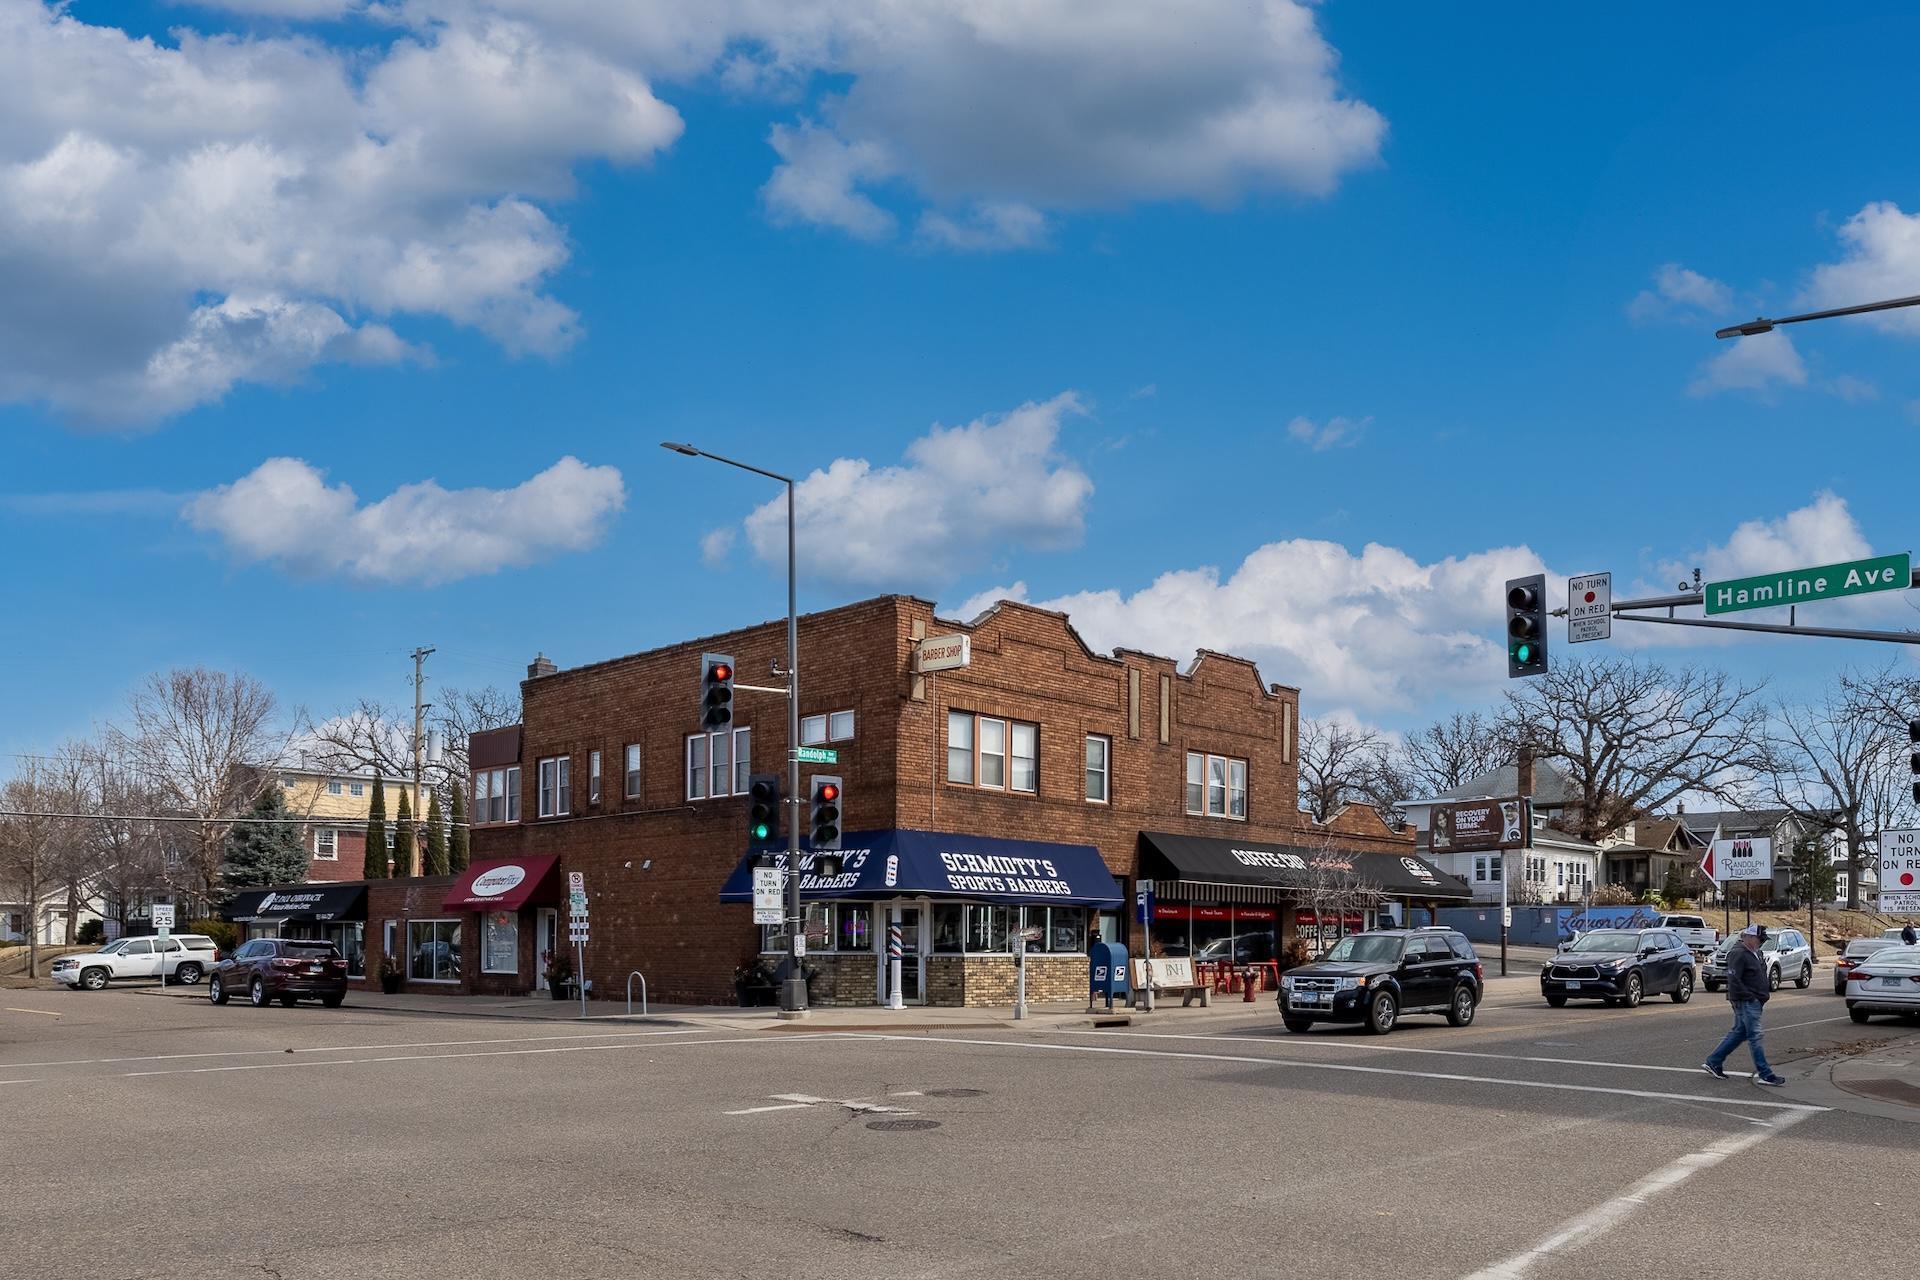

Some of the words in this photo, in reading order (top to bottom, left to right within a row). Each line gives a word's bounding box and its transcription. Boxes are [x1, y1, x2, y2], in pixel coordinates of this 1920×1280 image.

[1572, 582, 1584, 591] NO
[1587, 578, 1608, 589] TURN
[1717, 577, 1828, 607] Hamline
[1843, 567, 1896, 589] Ave
[1574, 607, 1586, 616] ON
[1589, 604, 1604, 614] RED
[1588, 617, 1606, 625] SCHOOL
[1582, 631, 1602, 639] PRESENT
[922, 648, 946, 661] BARBER
[946, 644, 962, 658] SHOP
[799, 748, 826, 761] Randolph
[1456, 808, 1490, 818] RECOVERY
[1898, 834, 1914, 844] NO
[1890, 846, 1920, 856] TURN
[940, 852, 1058, 878] SCHMIDTY'S
[1231, 849, 1286, 868] COFFEE
[1277, 853, 1307, 870] CUP
[1721, 859, 1764, 871] RANDOLPH
[1882, 860, 1898, 870] ON
[1906, 860, 1920, 868] RE
[1729, 866, 1760, 878] LIQUORS
[946, 874, 1006, 891] SPORTS
[1005, 878, 1072, 895] BARBERS
[155, 916, 172, 925] 25
[1559, 909, 1612, 933] Liquor
[1324, 925, 1337, 934] CUP
